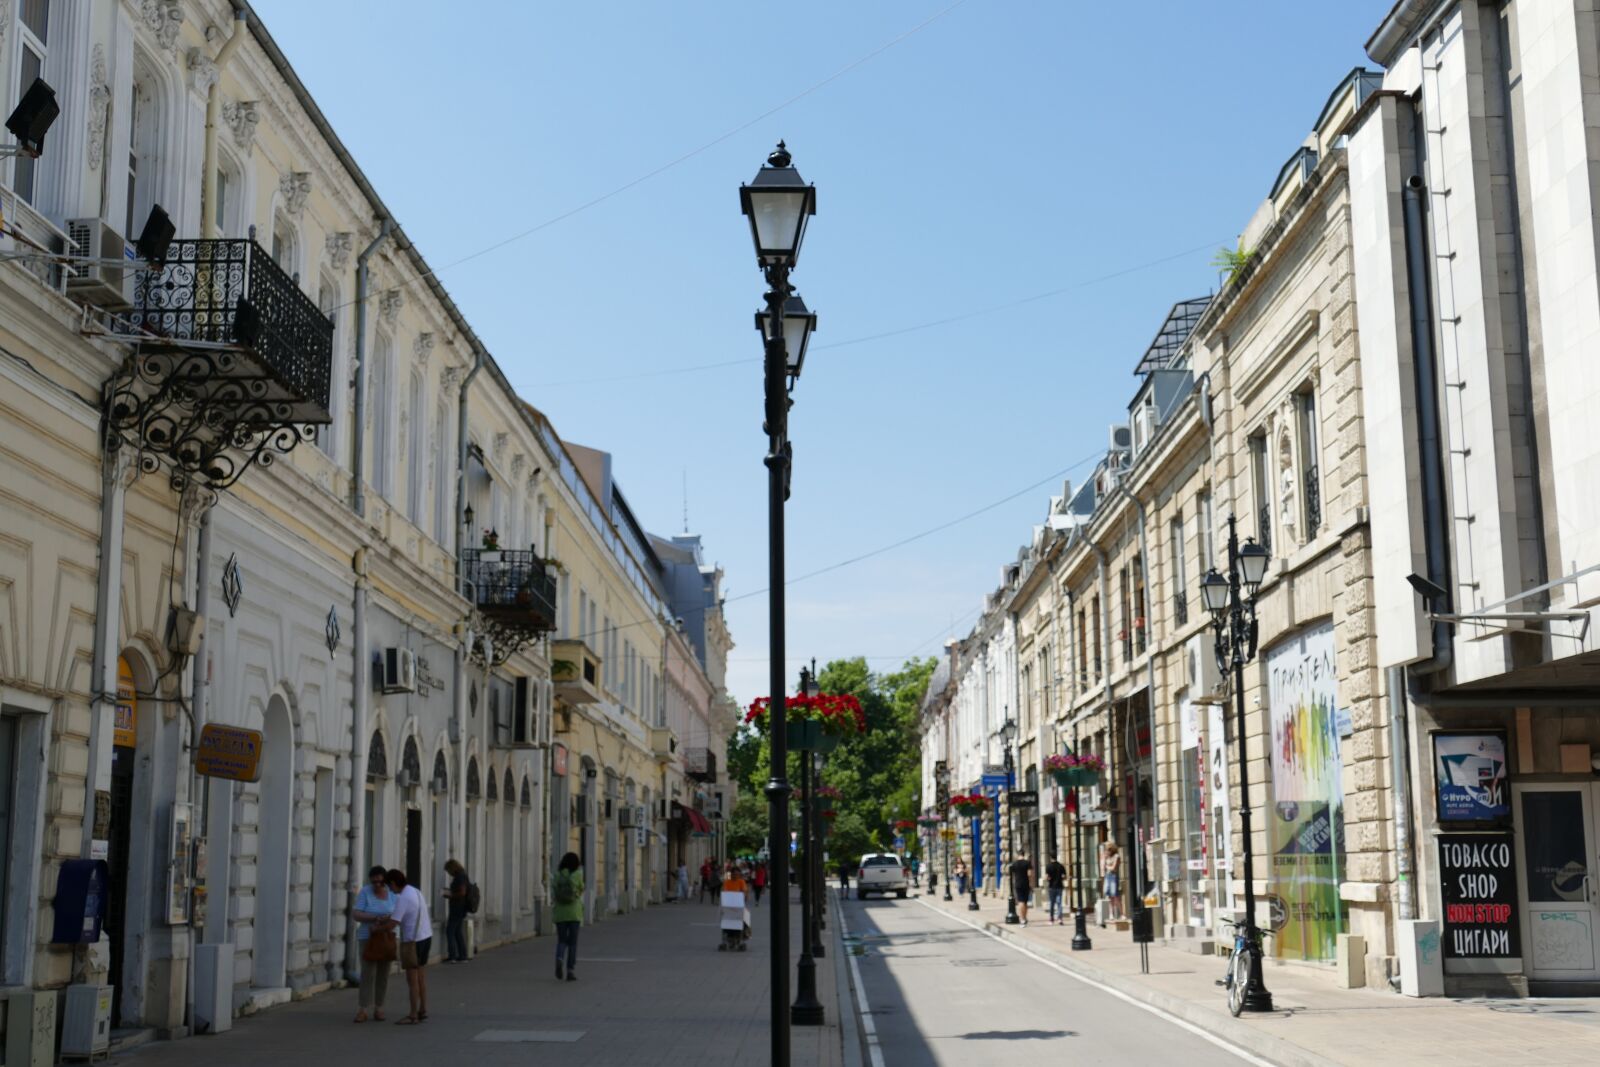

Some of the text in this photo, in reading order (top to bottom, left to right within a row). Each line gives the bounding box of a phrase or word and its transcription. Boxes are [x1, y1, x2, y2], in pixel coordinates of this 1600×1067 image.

[1442, 843, 1510, 868] TOBACCO
[1458, 873, 1498, 899] SHOP
[1446, 903, 1512, 923] NON STOP
[1453, 929, 1510, 956] ЦИГАРИ
